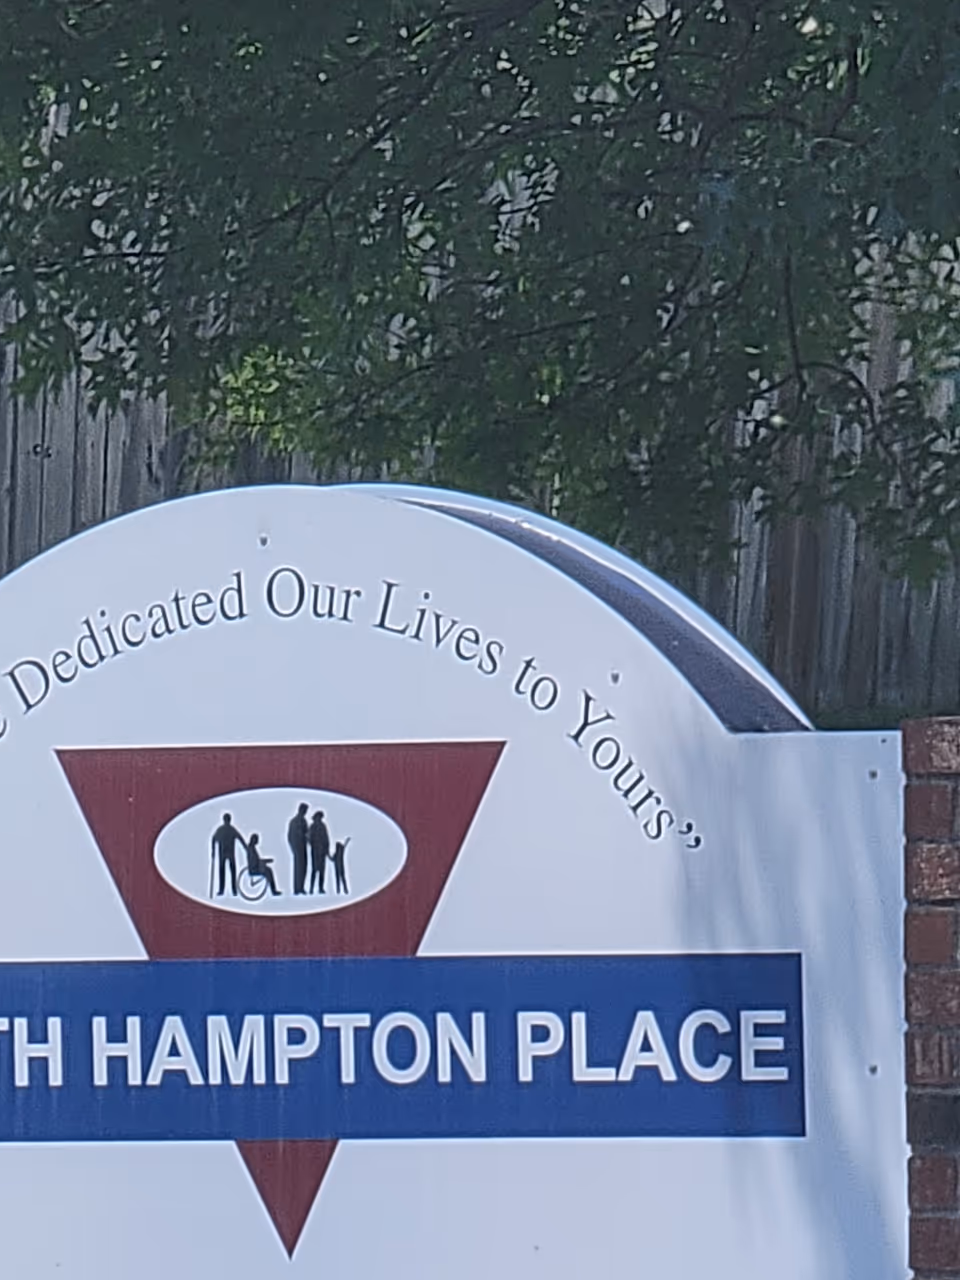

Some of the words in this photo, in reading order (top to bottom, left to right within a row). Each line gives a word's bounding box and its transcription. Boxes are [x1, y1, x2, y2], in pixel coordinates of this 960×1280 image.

[4, 571, 248, 714] Dedicated
[265, 566, 362, 622] Our
[371, 579, 505, 677] Lives
[512, 655, 560, 712] to
[567, 690, 702, 850] Yours”
[91, 1010, 487, 1086] HAMPTON
[517, 1008, 790, 1083] PLACE
